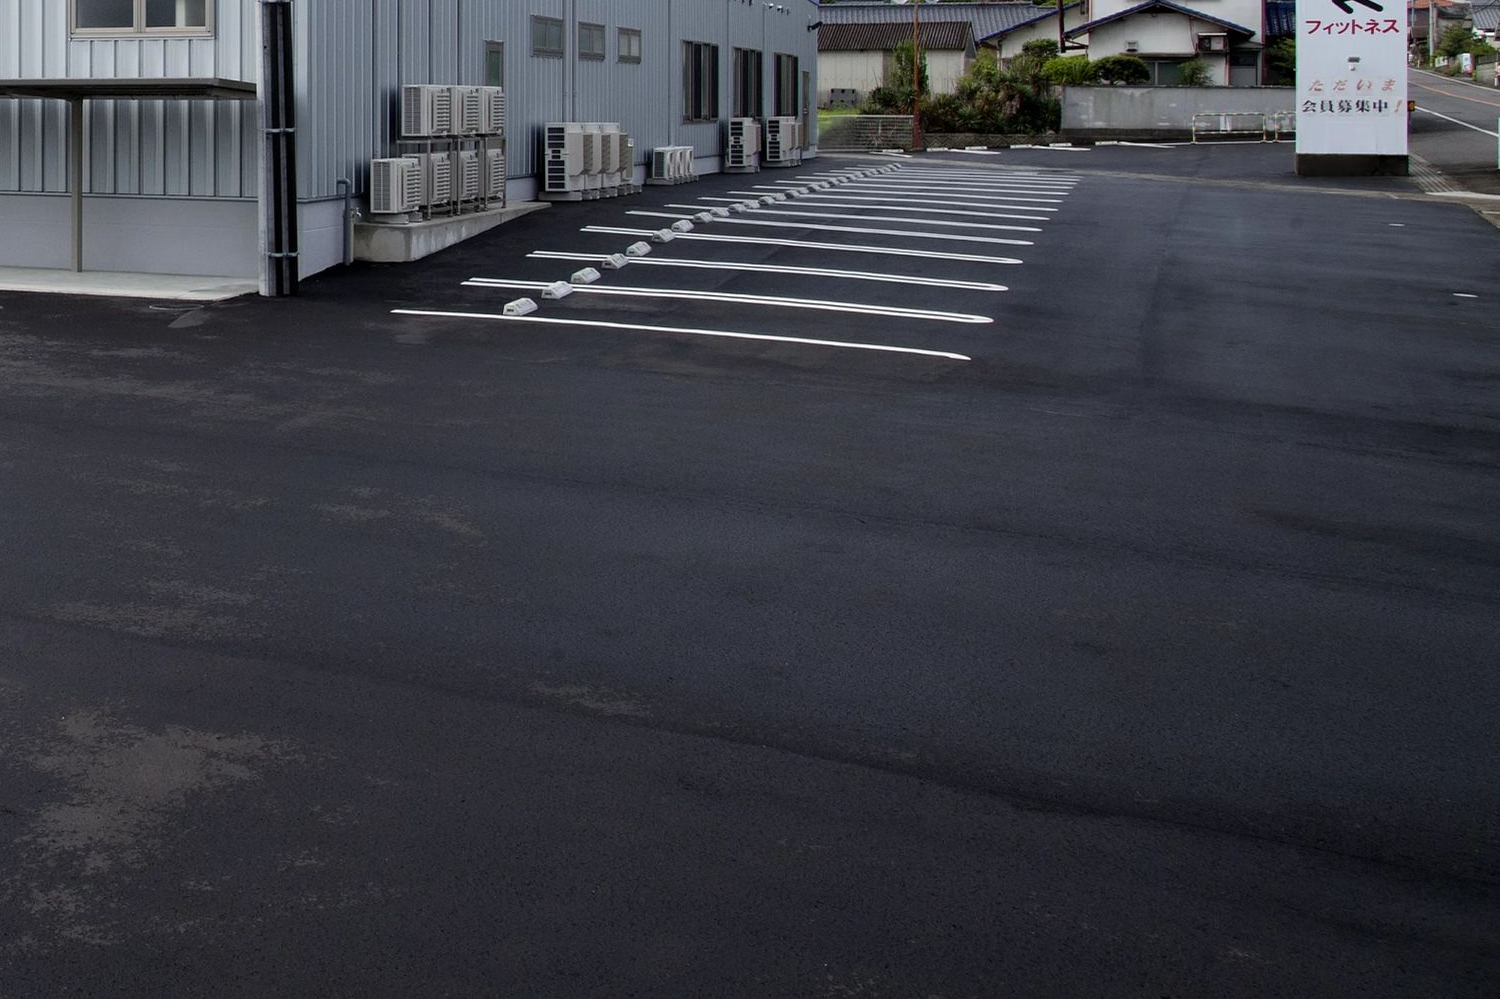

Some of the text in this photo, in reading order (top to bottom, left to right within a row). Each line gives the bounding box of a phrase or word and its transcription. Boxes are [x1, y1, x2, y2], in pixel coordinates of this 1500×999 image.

[1305, 19, 1400, 35] フィットネス
[1308, 78, 1397, 93] ただいま
